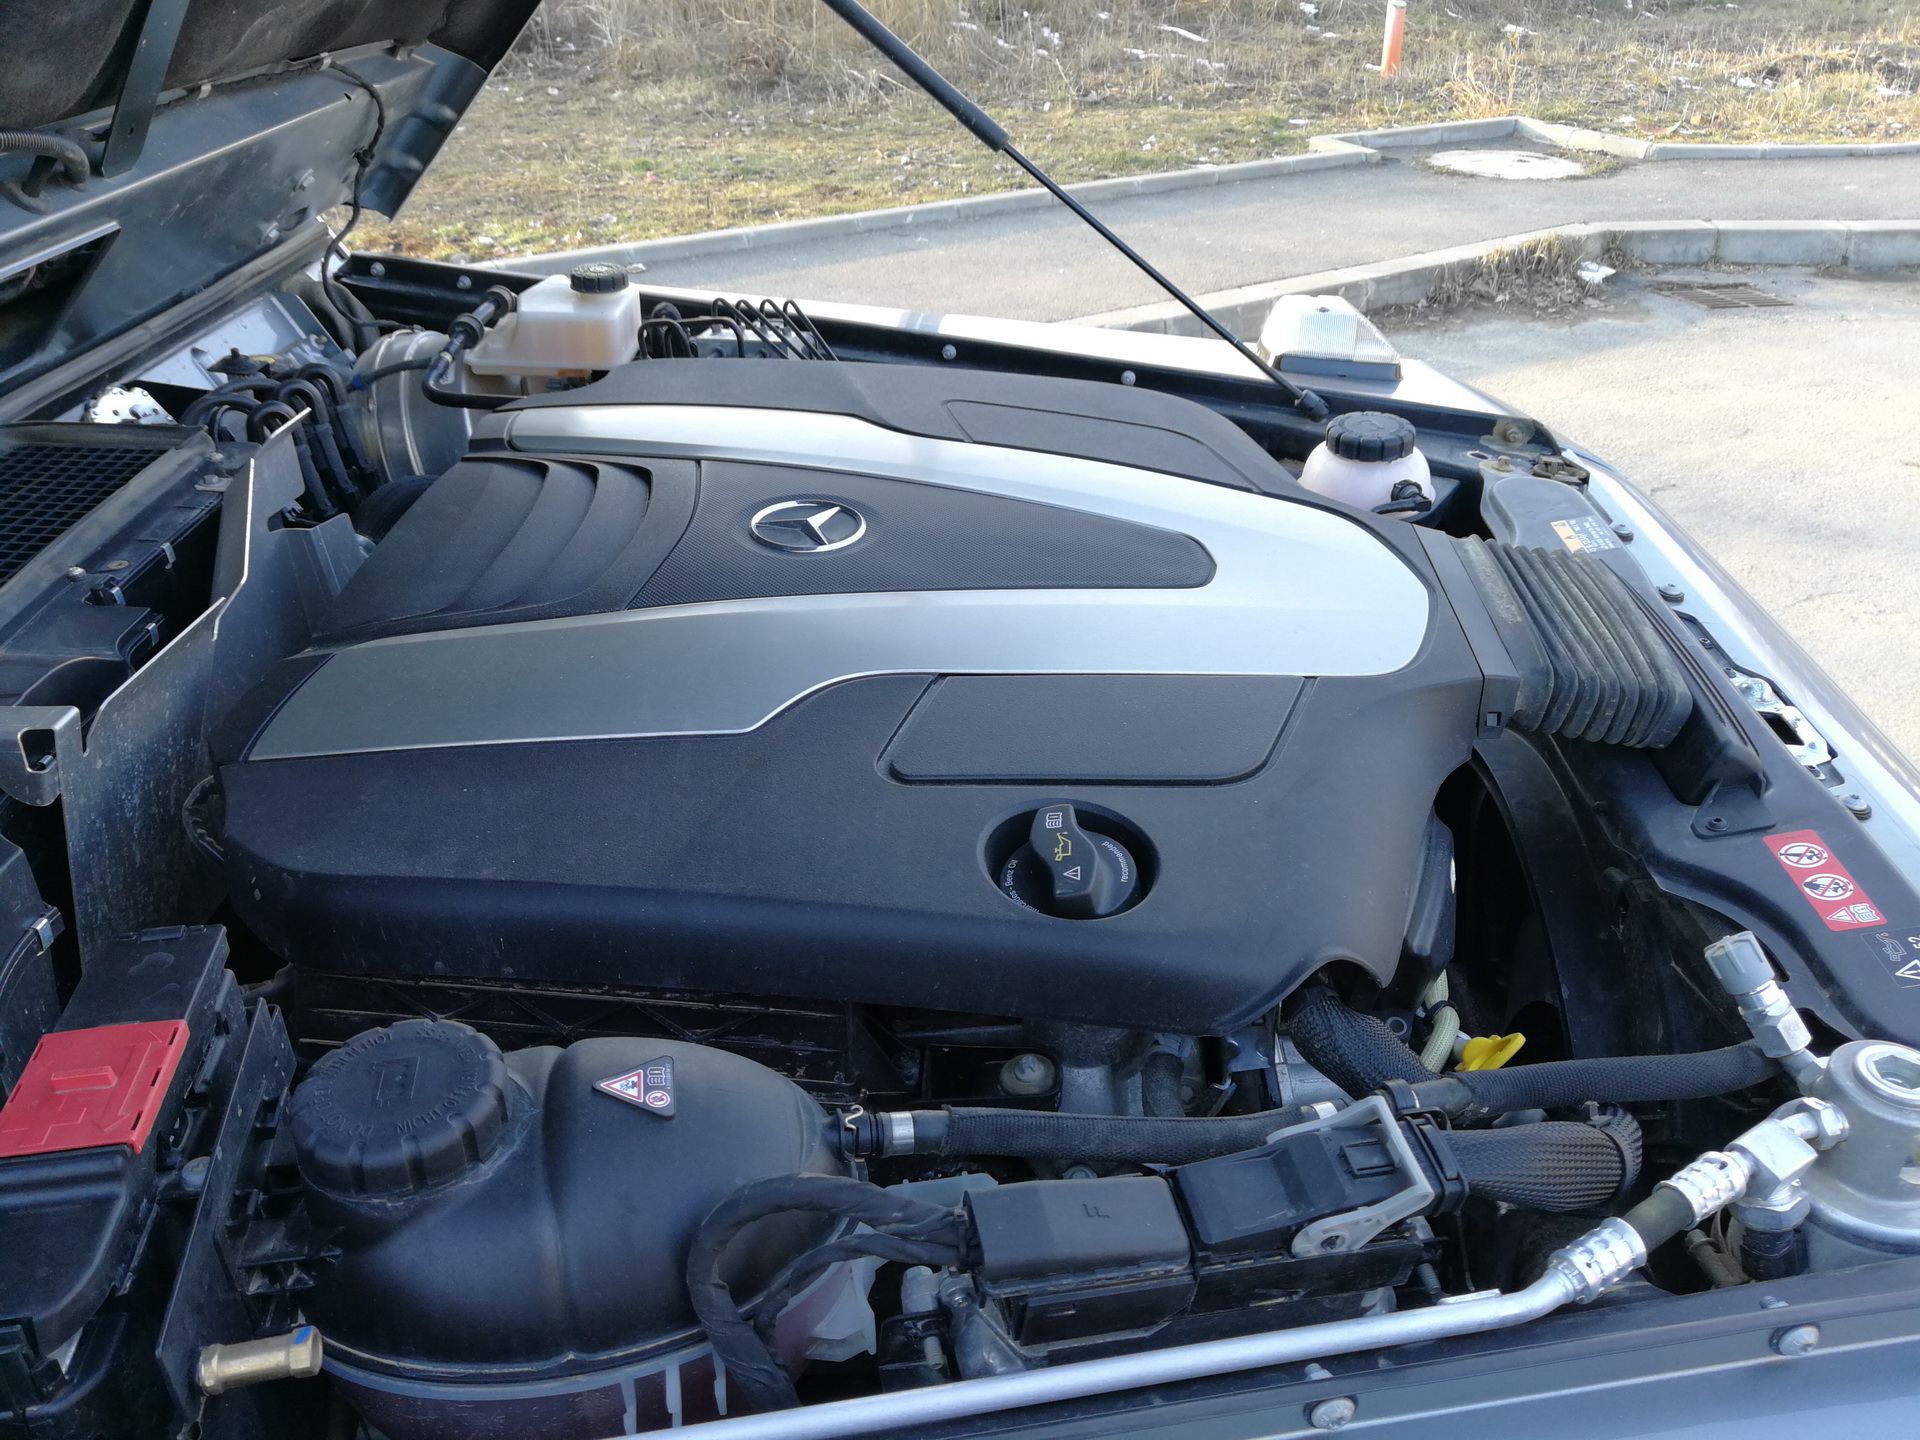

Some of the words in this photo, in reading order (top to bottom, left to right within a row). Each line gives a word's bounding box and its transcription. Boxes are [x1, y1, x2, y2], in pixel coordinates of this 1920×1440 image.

[1008, 859, 1019, 869] Oil
[1101, 841, 1129, 882] recommended
[396, 1108, 442, 1134] NICHT
